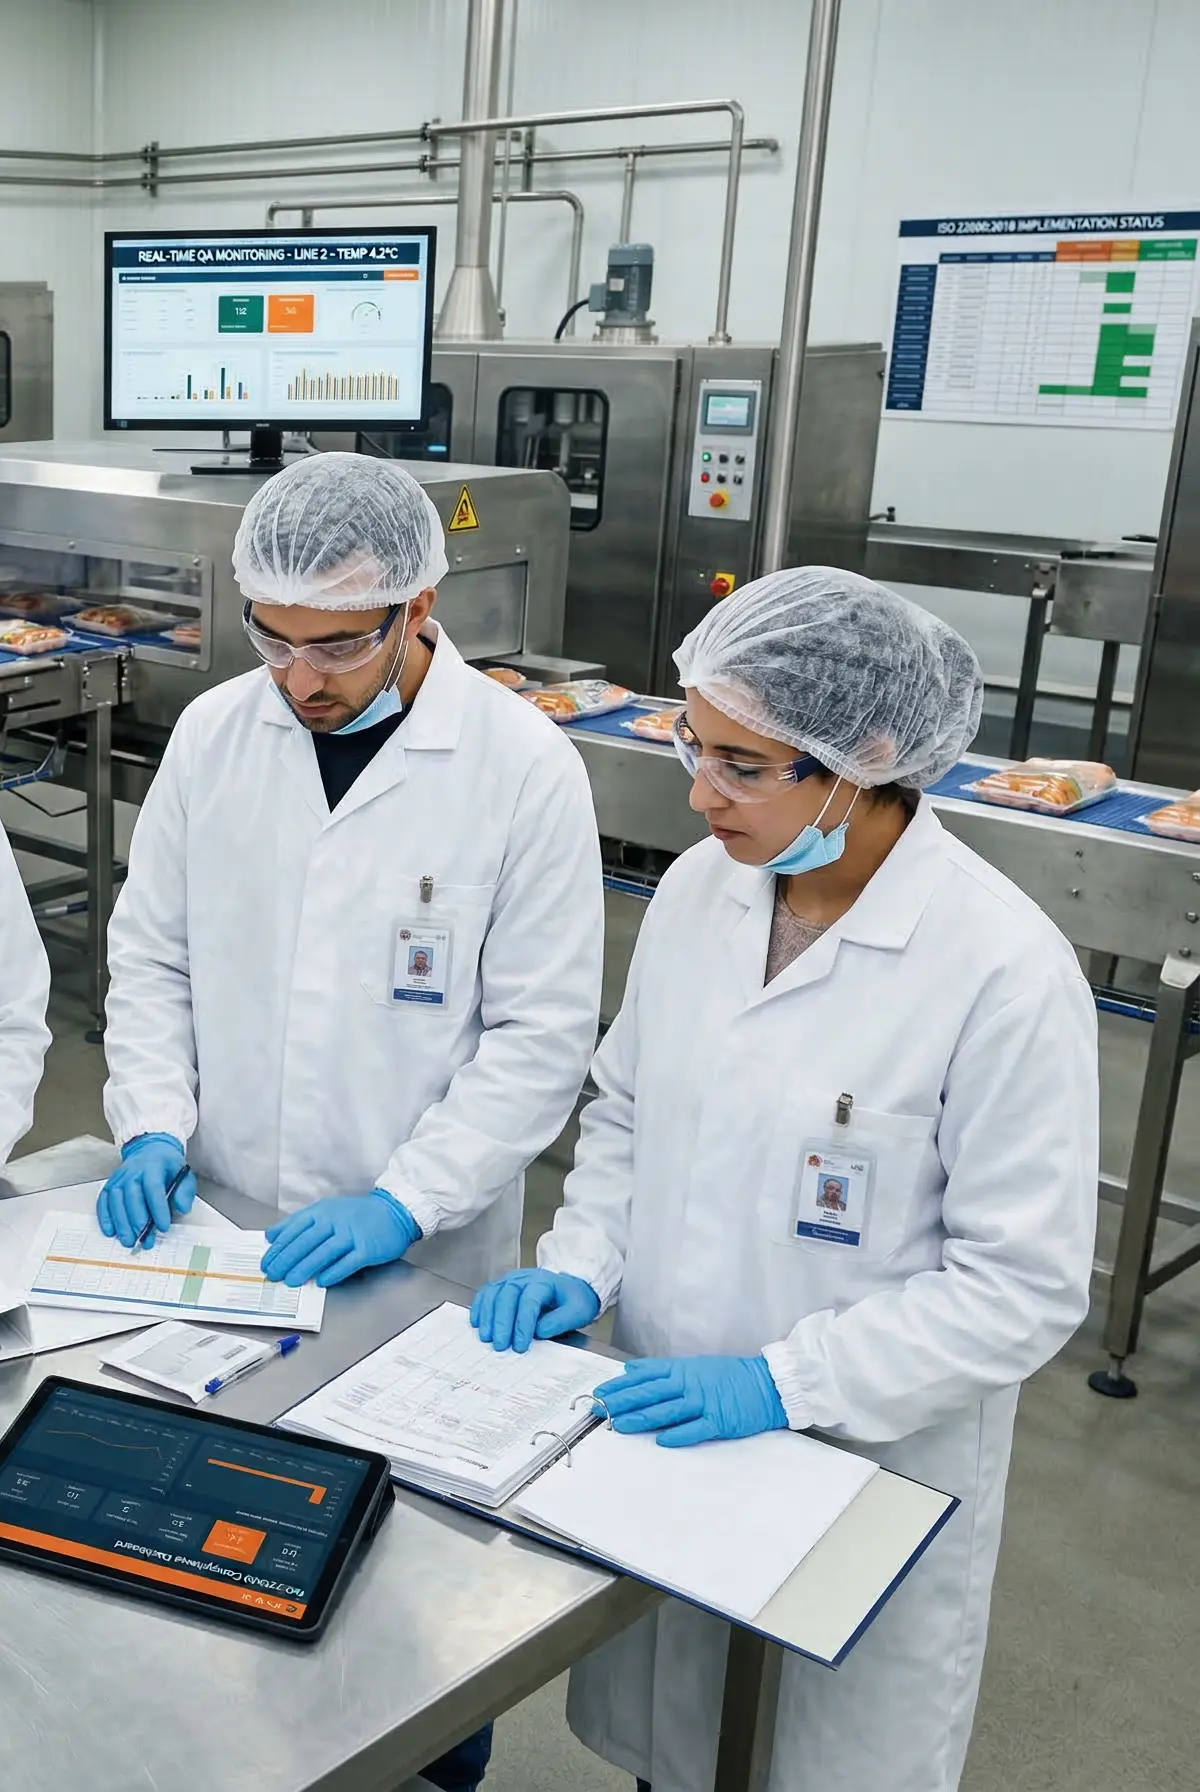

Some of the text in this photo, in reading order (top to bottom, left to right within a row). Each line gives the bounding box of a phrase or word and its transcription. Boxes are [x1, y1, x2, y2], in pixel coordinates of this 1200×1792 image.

[1119, 216, 1165, 229] STATUS
[138, 249, 196, 262] REAL-TIME
[197, 249, 214, 263] QA
[216, 248, 285, 261] MONITORING
[294, 248, 319, 260] LINE
[320, 248, 328, 260] 2
[337, 247, 368, 260] TEMP
